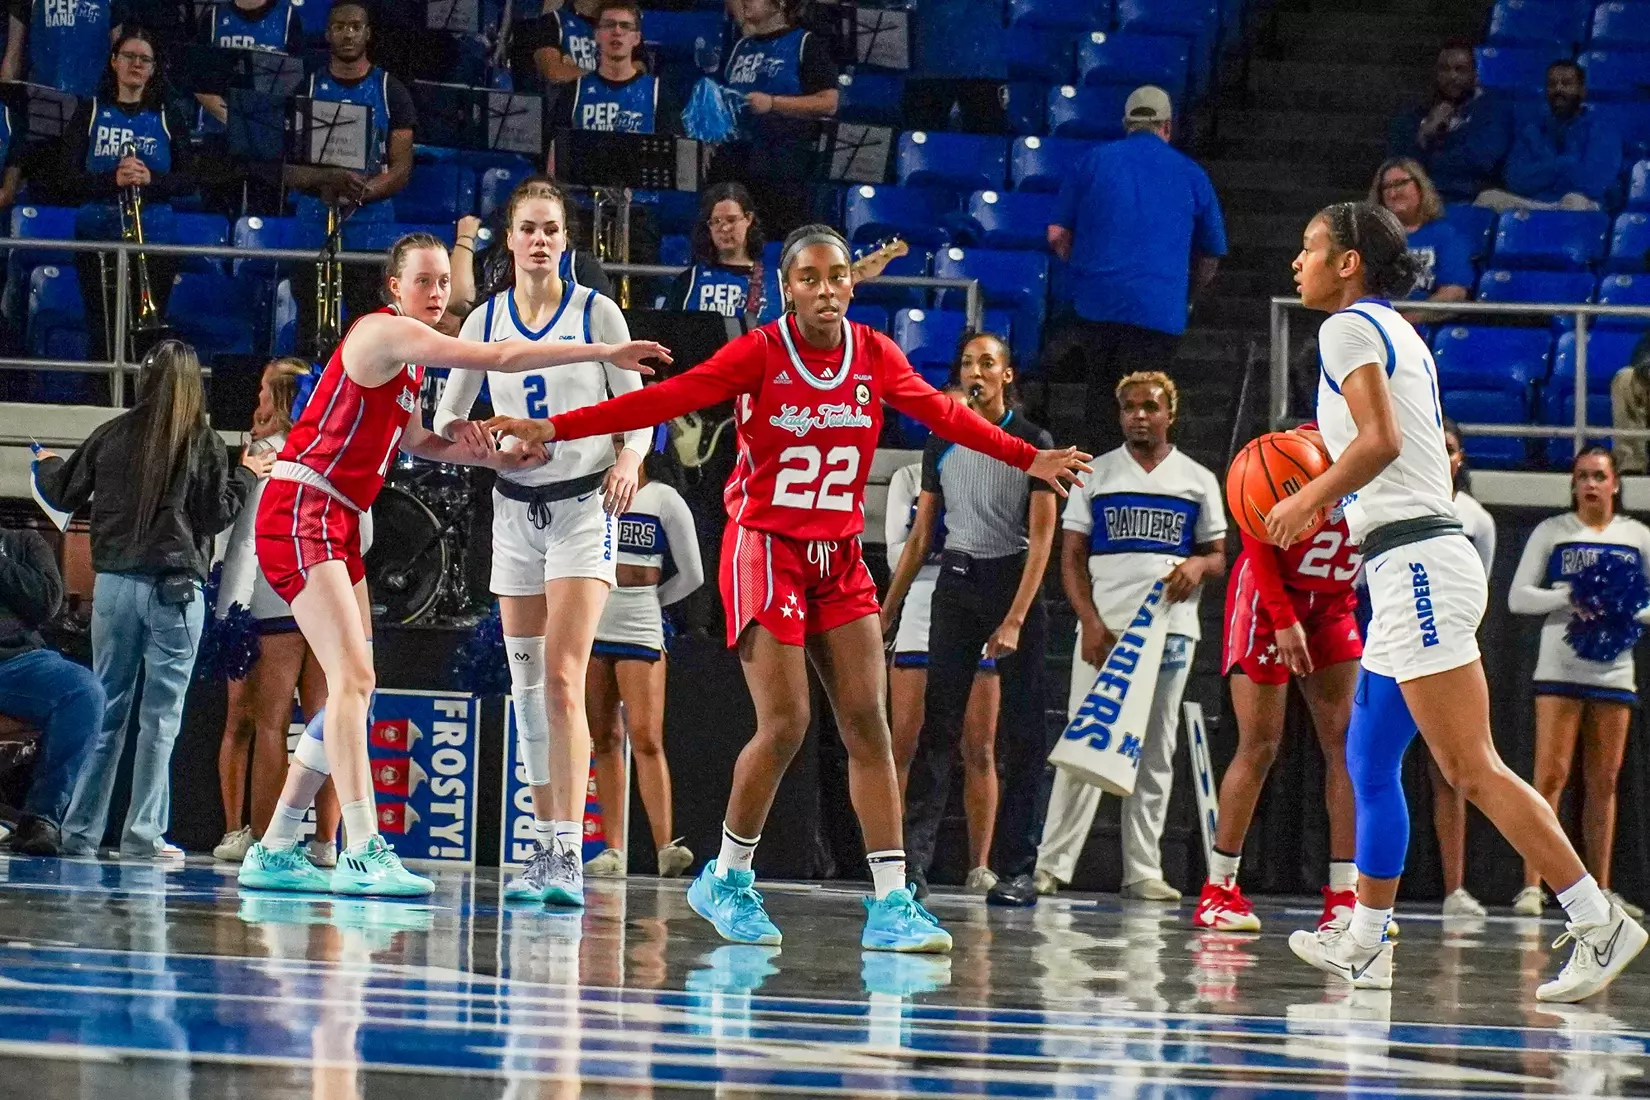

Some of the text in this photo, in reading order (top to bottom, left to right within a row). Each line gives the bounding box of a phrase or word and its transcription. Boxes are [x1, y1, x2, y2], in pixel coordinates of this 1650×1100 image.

[45, 13, 75, 27] BAND
[583, 102, 620, 126] PEP
[96, 125, 135, 146] PEP
[699, 302, 736, 317] BAND
[700, 283, 742, 306] PEP
[523, 375, 550, 419] 2
[769, 403, 814, 437] Lady
[771, 445, 861, 513] 22
[618, 520, 656, 548] ERS
[1103, 506, 1187, 546] RAIDERS
[1409, 562, 1440, 648] RAIDERS
[429, 699, 469, 859] FROSTY!
